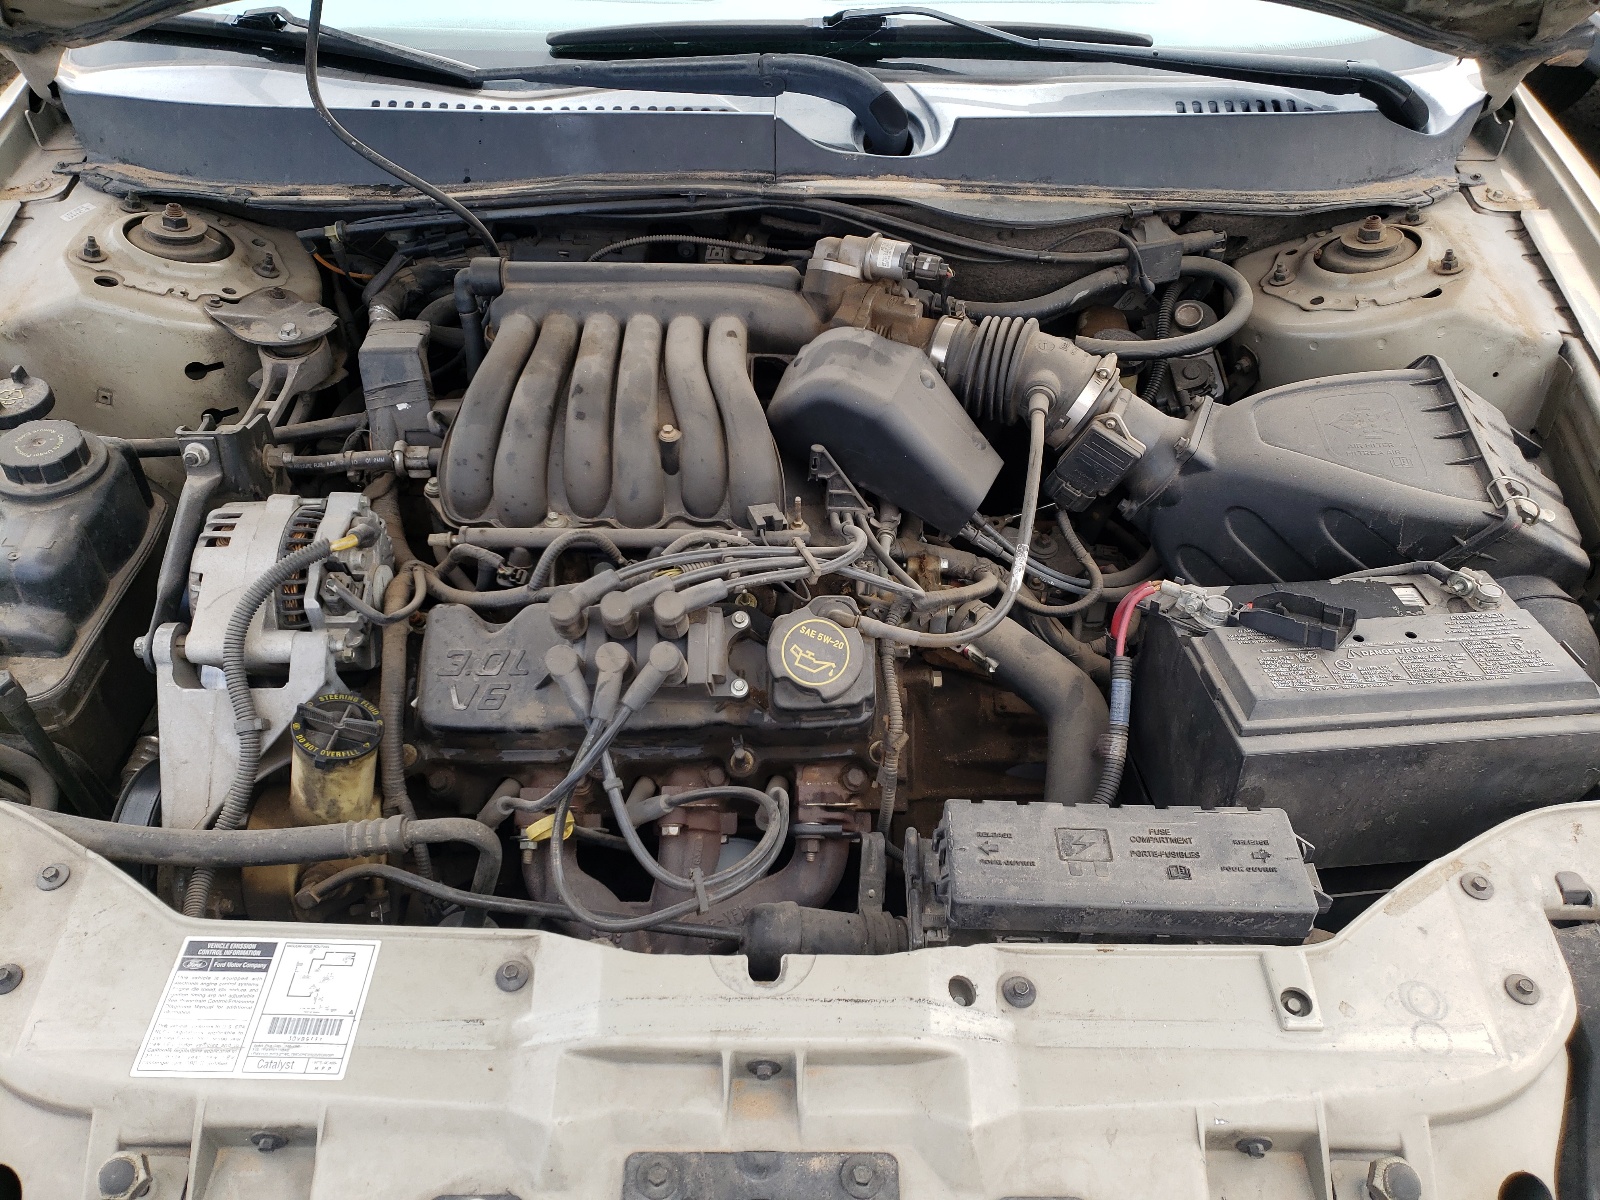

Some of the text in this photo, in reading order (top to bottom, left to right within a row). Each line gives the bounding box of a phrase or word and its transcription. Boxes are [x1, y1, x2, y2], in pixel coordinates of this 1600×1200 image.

[799, 625, 845, 650] SAE 5W-20
[436, 650, 529, 677] 3.0L
[318, 693, 380, 716] STEERING FLUID
[450, 683, 511, 711] V6
[295, 734, 360, 757] DO NOT OVERFILL
[1129, 836, 1193, 845] COMPARTMENT
[1148, 828, 1172, 836] FUSE
[242, 961, 268, 970] Company
[256, 1058, 295, 1072] Catalyst
